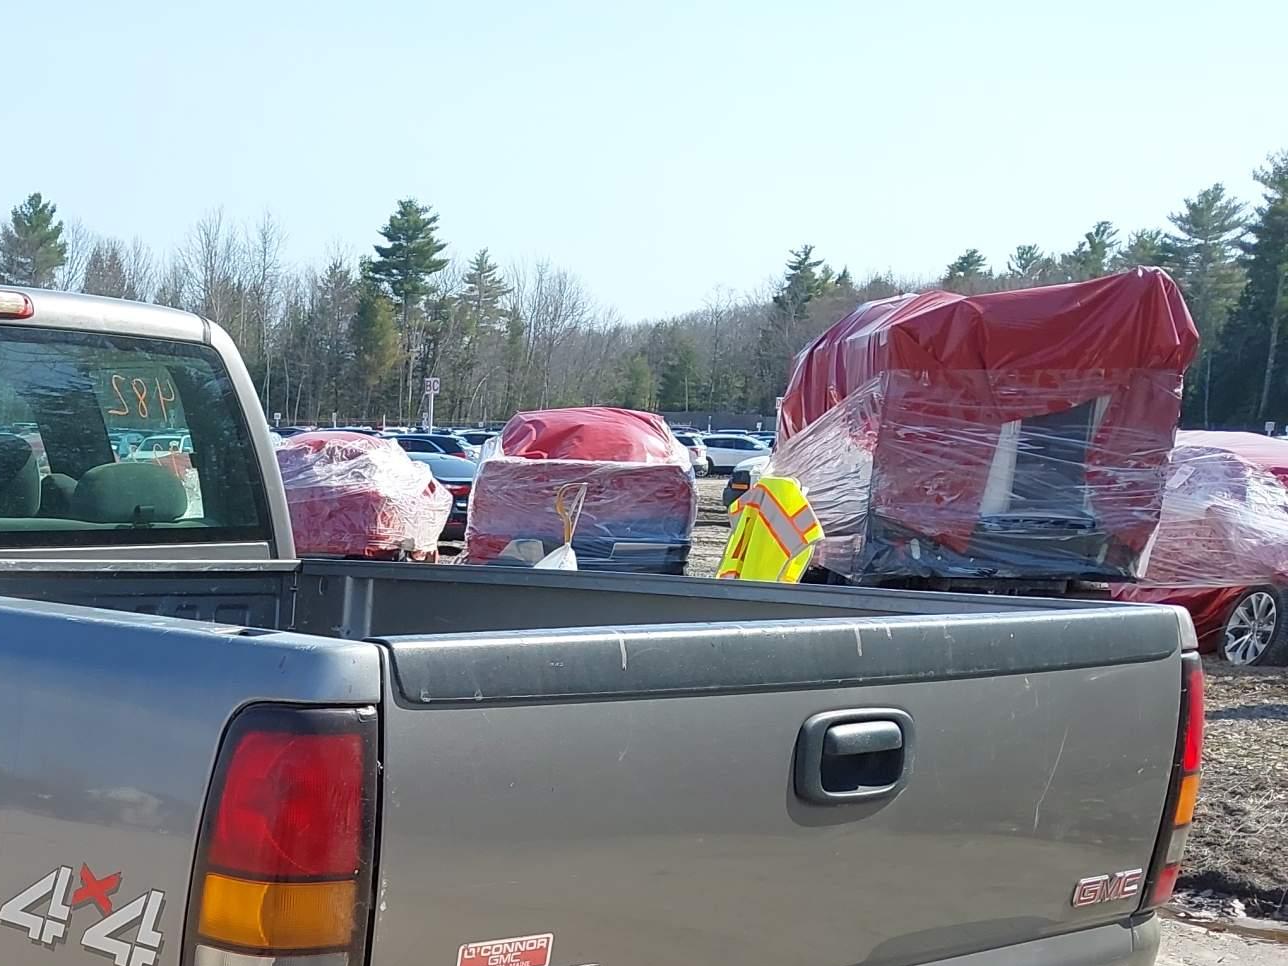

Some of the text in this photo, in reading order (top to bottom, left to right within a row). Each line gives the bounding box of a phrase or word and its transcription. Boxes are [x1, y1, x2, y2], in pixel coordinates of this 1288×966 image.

[425, 380, 440, 392] BC
[1073, 868, 1142, 907] GMC
[464, 938, 548, 959] O'CONNOR
[488, 951, 521, 966] GMC
